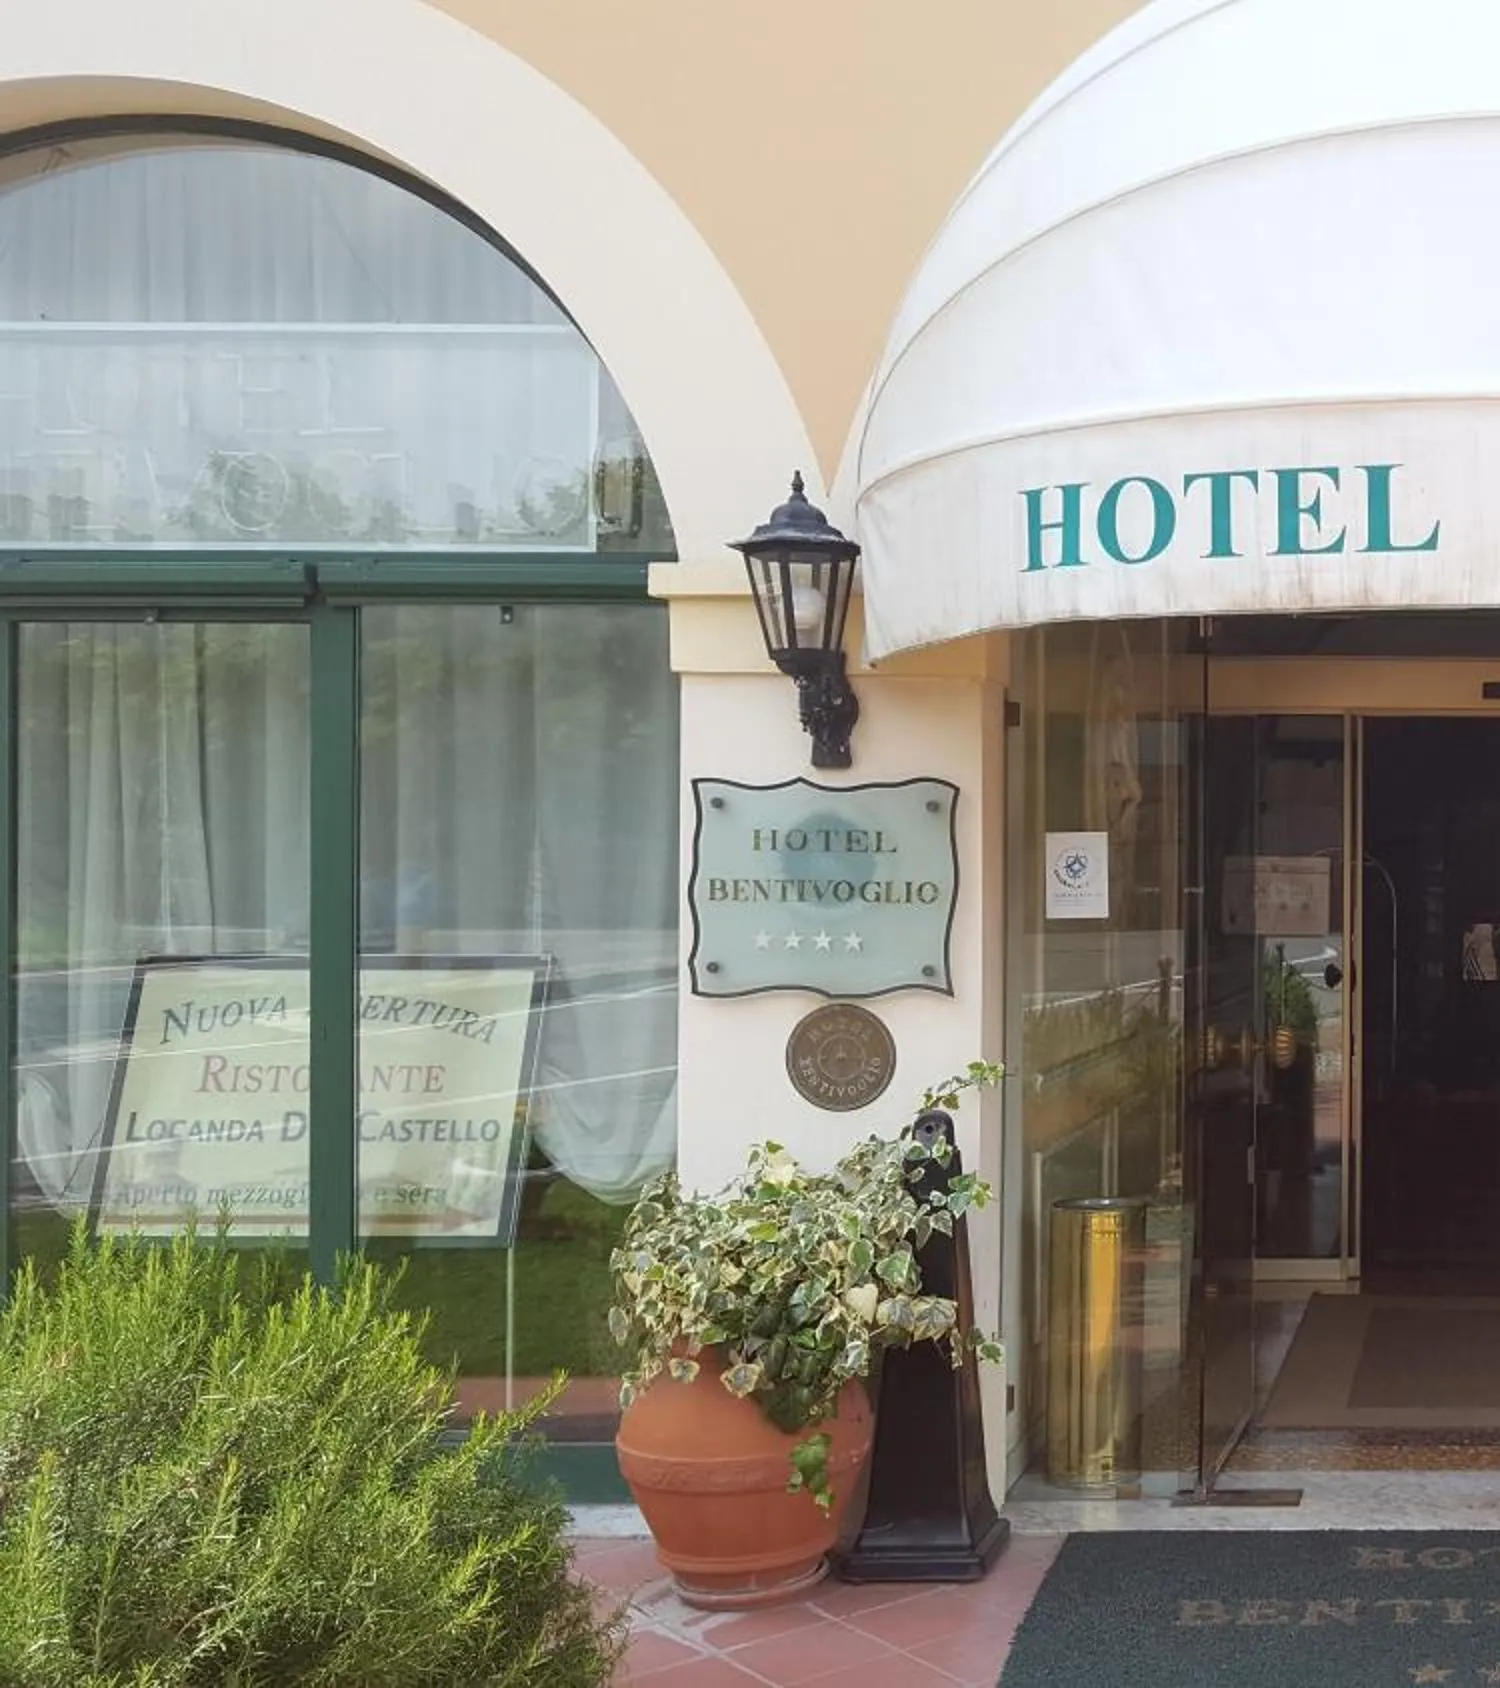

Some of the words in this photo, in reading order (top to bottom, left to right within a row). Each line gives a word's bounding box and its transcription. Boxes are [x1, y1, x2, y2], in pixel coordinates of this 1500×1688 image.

[1018, 462, 1441, 573] HOTEL
[752, 828, 898, 854] HOTEL
[707, 878, 940, 905] BENTIVOGLIO
[306, 994, 498, 1046] ERTURA
[194, 1054, 447, 1094] RISTONTE
[126, 1111, 264, 1142] LOCANDA
